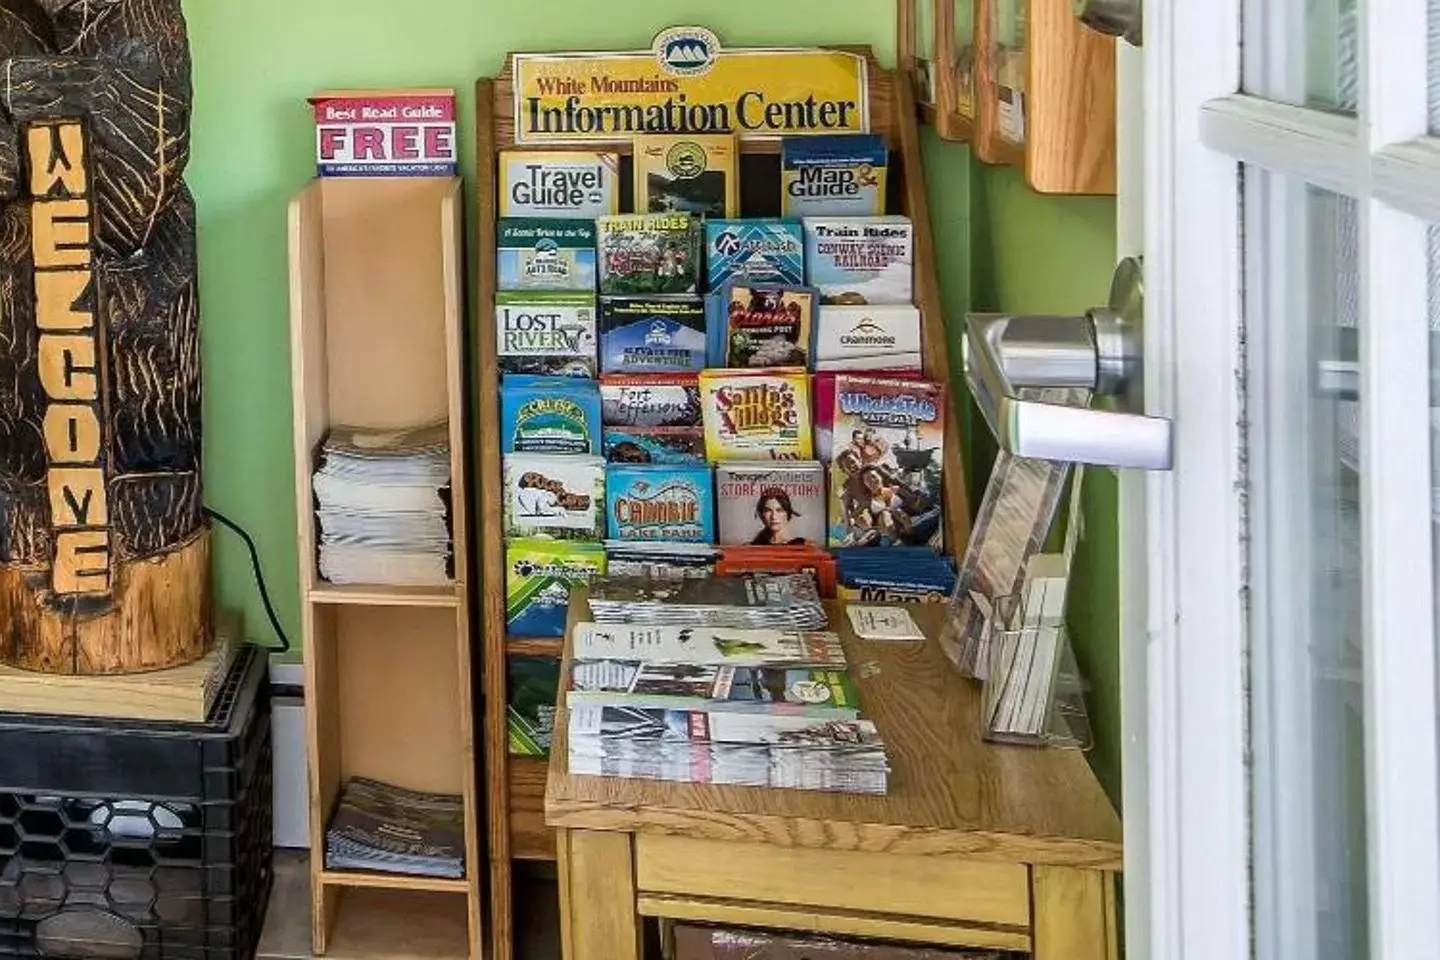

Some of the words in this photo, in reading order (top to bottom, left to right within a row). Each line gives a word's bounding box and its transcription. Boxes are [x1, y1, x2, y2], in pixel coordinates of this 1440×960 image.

[536, 77, 587, 96] White
[590, 74, 679, 94] Mountains
[326, 107, 356, 120] Best
[362, 105, 397, 119] Read
[401, 104, 444, 119] Guide
[526, 94, 730, 133] Information
[736, 91, 857, 131] Center
[319, 126, 453, 161] FREE
[526, 164, 603, 189] Travel
[799, 166, 855, 187] Map
[511, 181, 584, 205] Guide
[788, 180, 860, 198] Guide
[600, 218, 643, 232] TRAIN
[648, 216, 689, 231] RIDES
[816, 225, 860, 238] Train
[863, 226, 908, 238] Rides
[817, 242, 864, 255] CONWAY
[867, 242, 906, 256] SCENIC
[833, 253, 890, 268] RAILROAD
[504, 308, 563, 332] LOST
[504, 330, 567, 353] RIVER
[618, 387, 652, 402] Fort
[715, 382, 797, 412] Santa's
[717, 404, 799, 434] Village
[720, 483, 758, 497] STORE
[760, 483, 821, 497] DIRECTORY
[661, 529, 704, 538] PARK
[861, 587, 922, 603] Map
